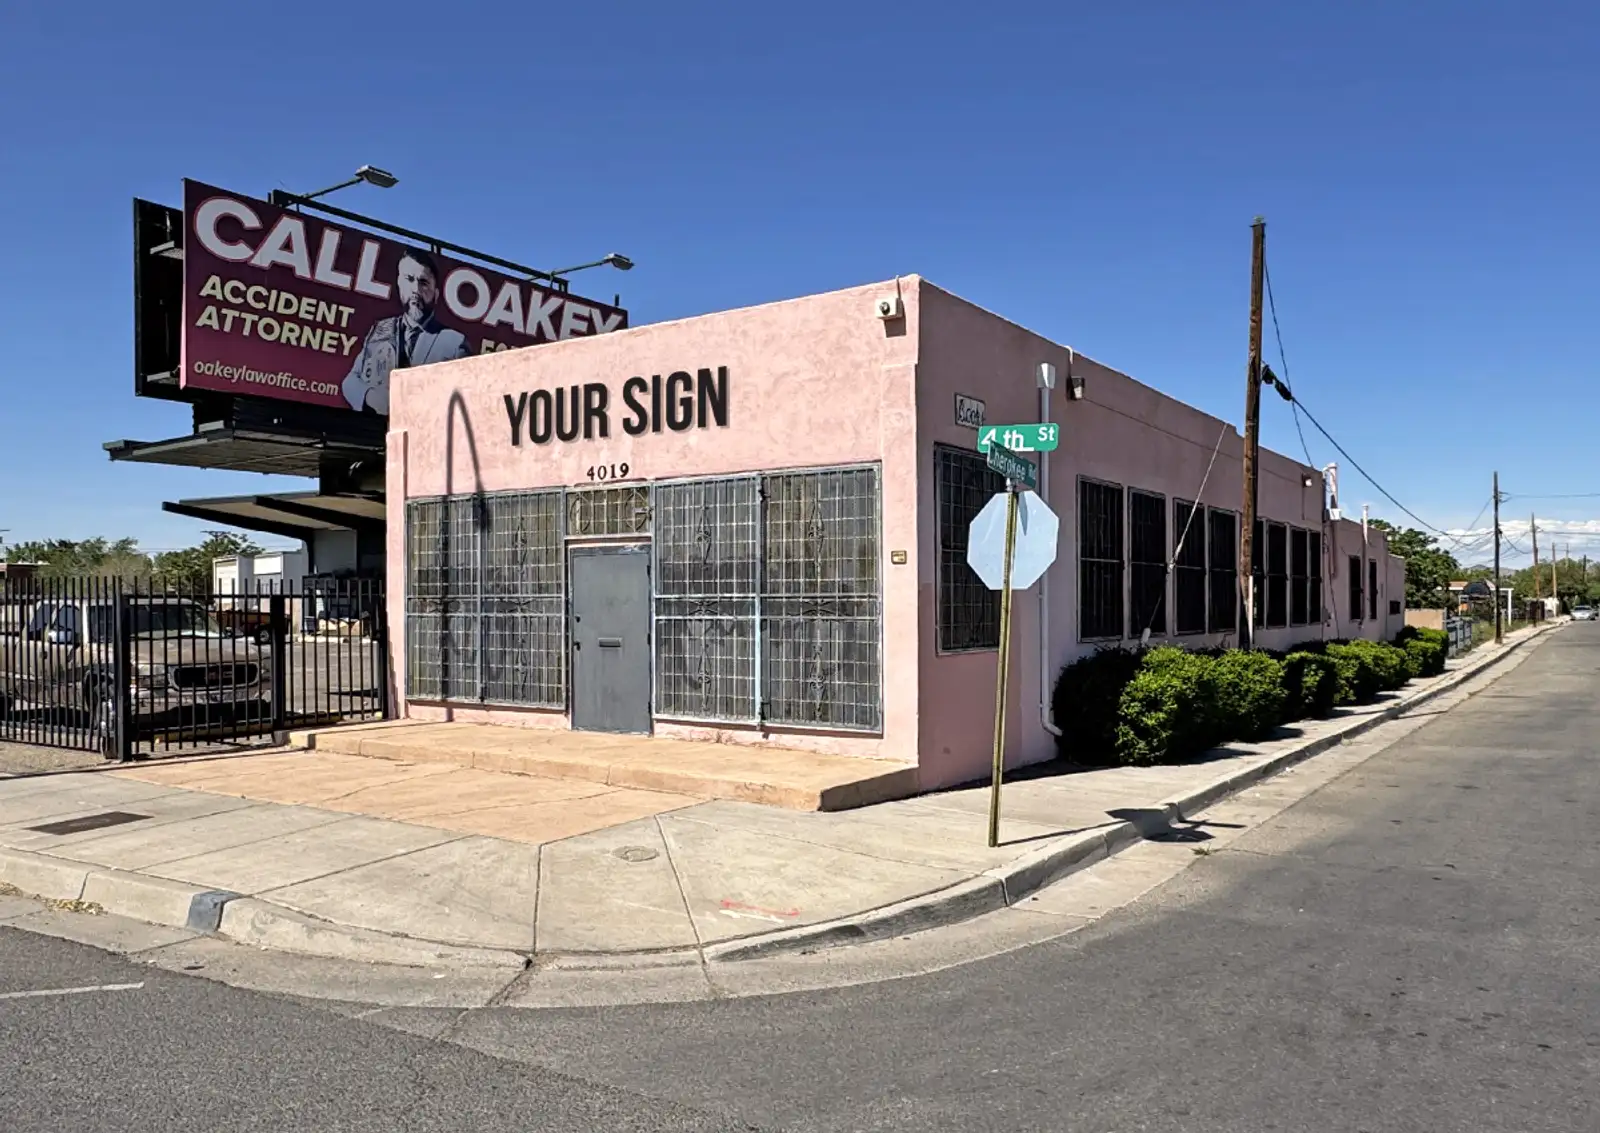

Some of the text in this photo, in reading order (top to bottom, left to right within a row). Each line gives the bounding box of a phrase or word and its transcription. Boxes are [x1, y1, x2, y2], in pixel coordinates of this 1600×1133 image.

[194, 196, 623, 341] CALL OAKEY
[199, 275, 355, 328] ACCIDENT
[195, 305, 359, 356] ATTORNEY
[194, 360, 339, 396] oakeylawoffice.com
[503, 366, 730, 447] YOUR SIGN
[1037, 426, 1055, 441] St
[586, 462, 629, 481] 4019
